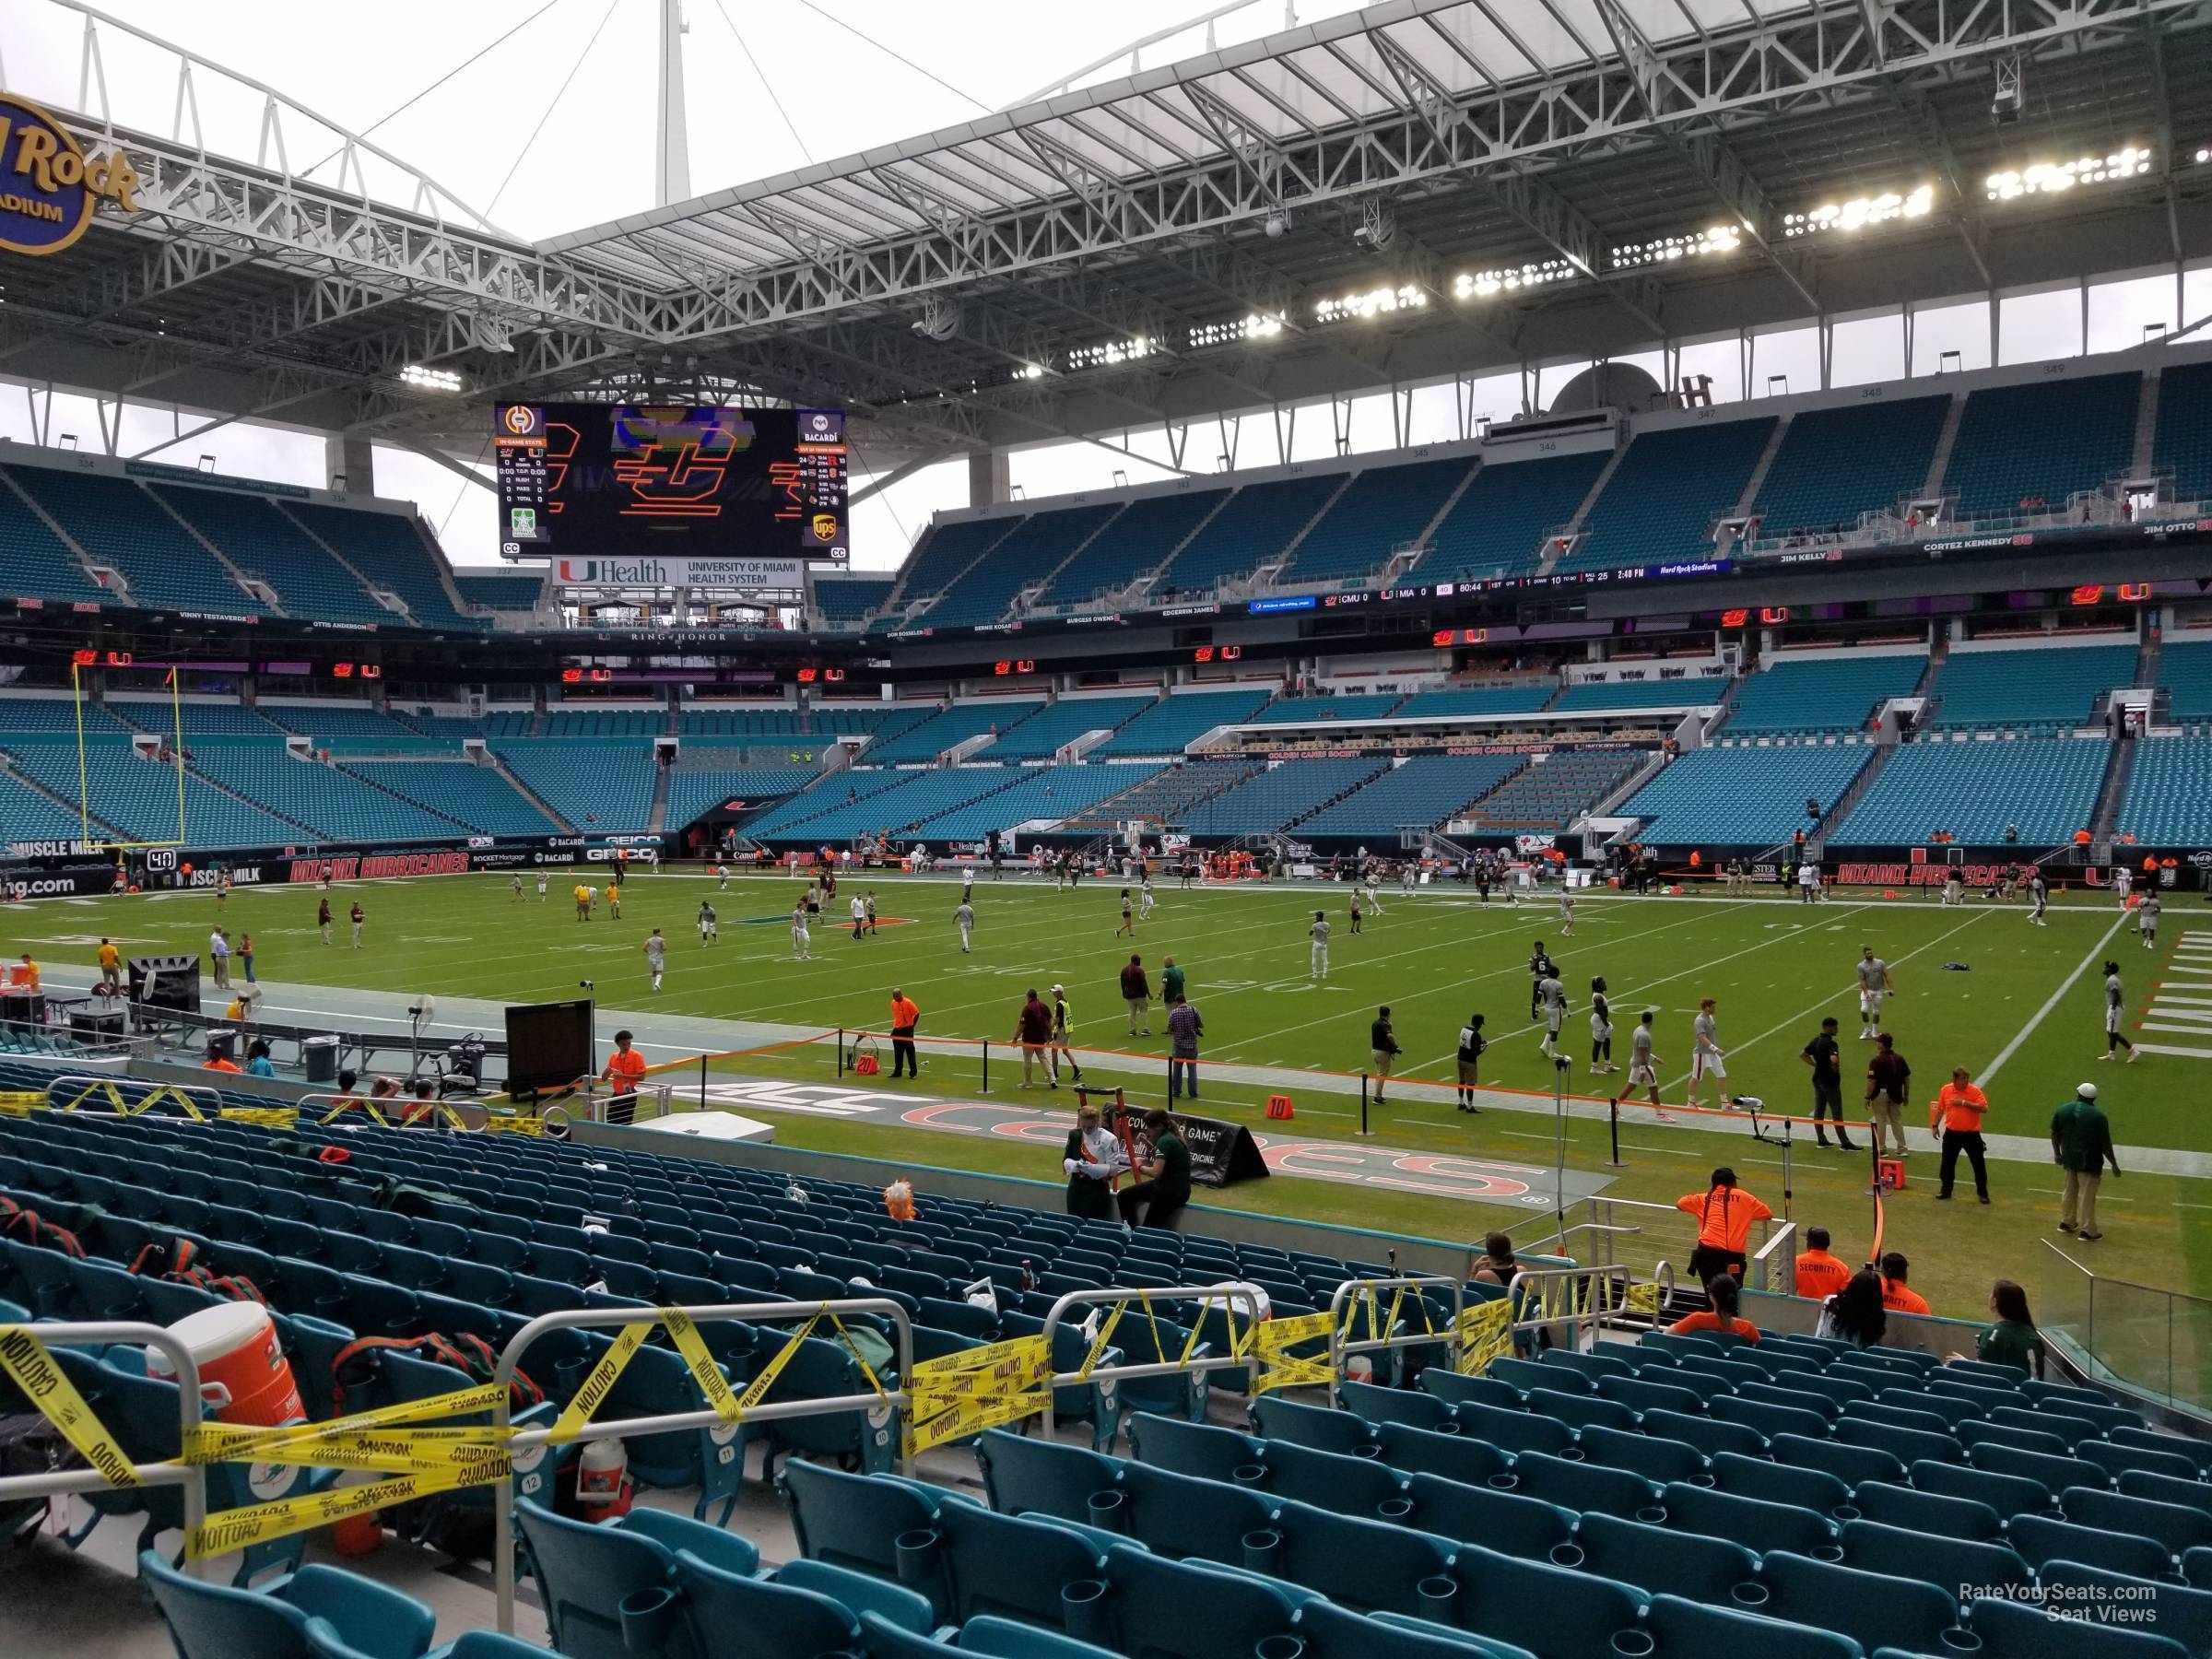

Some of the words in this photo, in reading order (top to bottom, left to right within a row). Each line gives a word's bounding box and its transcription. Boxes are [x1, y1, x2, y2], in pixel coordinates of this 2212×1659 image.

[16, 124, 139, 212] Rock
[1538, 442, 1558, 453] 346
[2144, 525, 2163, 535] JIM
[2165, 523, 2196, 533] OTTO
[1924, 542, 1962, 551] CORTEZ
[1964, 536, 2013, 548] KENNEDY
[1798, 552, 1826, 561] KELLY
[688, 562, 746, 572] UNIVERSITY
[747, 562, 761, 572] OF
[763, 562, 796, 572] MIAMI
[1660, 566, 1676, 575] Hard
[1676, 565, 1691, 574] Rock
[1691, 563, 1717, 571] Stadium
[688, 573, 726, 583] HEALTH
[727, 574, 768, 584] SYSTEM
[1597, 572, 1608, 581] 25
[1618, 570, 1632, 579] 2:40
[1634, 569, 1644, 578] PM
[1341, 594, 1360, 604] CMU
[1362, 594, 1369, 602] 0
[1399, 589, 1414, 598] MIA
[1420, 588, 1427, 596] 0
[203, 612, 247, 622] TESTAVERDE
[1162, 607, 1193, 617] EDGERRIN
[332, 621, 367, 630] ANDERSON
[1267, 751, 1300, 760] GOLDEN
[1300, 750, 1327, 759] CANES
[1327, 749, 1361, 758] SOCIETY
[1447, 746, 1483, 756] GOLDEN
[1484, 745, 1514, 754] CANES
[1515, 744, 1555, 754] SOCIETY
[558, 836, 585, 845] BACARDÍ
[606, 836, 661, 845] GEICO
[11, 841, 69, 857] MUSCLE
[70, 840, 104, 855] MILK
[151, 853, 172, 867] 40
[473, 854, 499, 863] ROCKET
[544, 852, 574, 862] BACARDÍ
[289, 857, 359, 883] MIAMI
[360, 852, 470, 878] HURRICANES
[1753, 865, 1776, 873] STER
[232, 867, 261, 882] MILK
[1837, 864, 1908, 885] MIAMI
[1910, 864, 2041, 886] HURICAES
[944, 964, 1046, 976] 30
[1194, 979, 1322, 993] 20
[856, 1057, 871, 1073] 20
[1270, 1098, 1286, 1116] 10
[1799, 1263, 1837, 1275] SECURITY
[1883, 1294, 1908, 1307] URITY
[994, 1357, 1021, 1382] CAUTION
[576, 1359, 618, 1417] CAUTION
[930, 1409, 960, 1441] CUIDADO
[723, 1449, 732, 1460] 11
[457, 1458, 512, 1486] CUIDADO
[524, 1477, 538, 1490] 12
